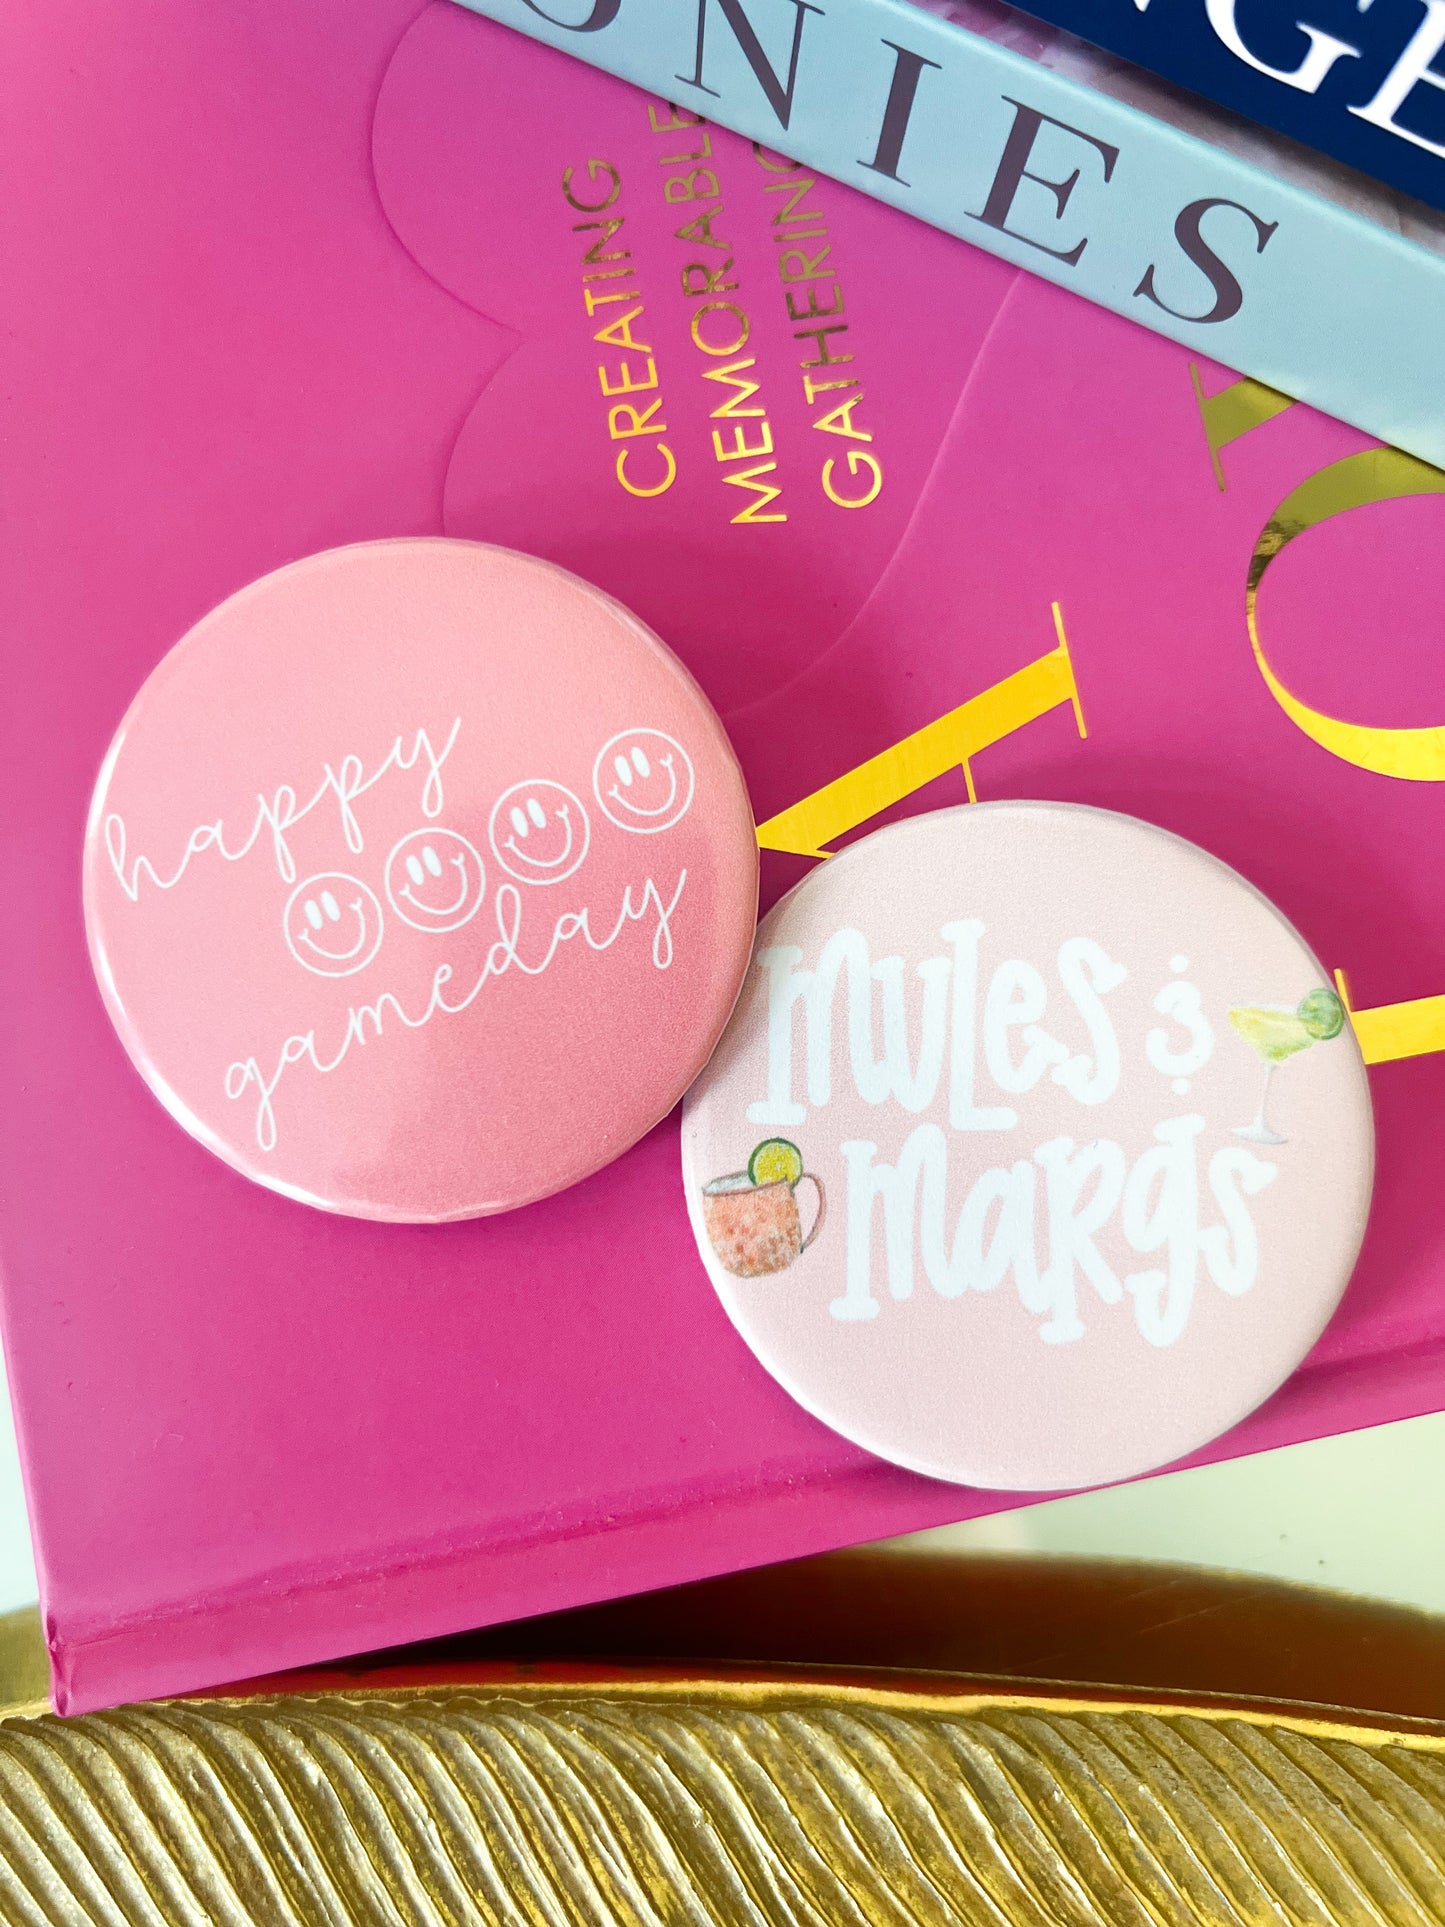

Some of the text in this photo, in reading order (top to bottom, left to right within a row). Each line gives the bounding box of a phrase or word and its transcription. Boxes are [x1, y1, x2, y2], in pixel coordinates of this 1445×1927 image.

[562, 158, 676, 498] CREATING
[647, 102, 788, 525] MEMORABLE
[105, 716, 462, 902] happy
[225, 868, 687, 1151] gameday
[1145, 953, 1216, 1096] &
